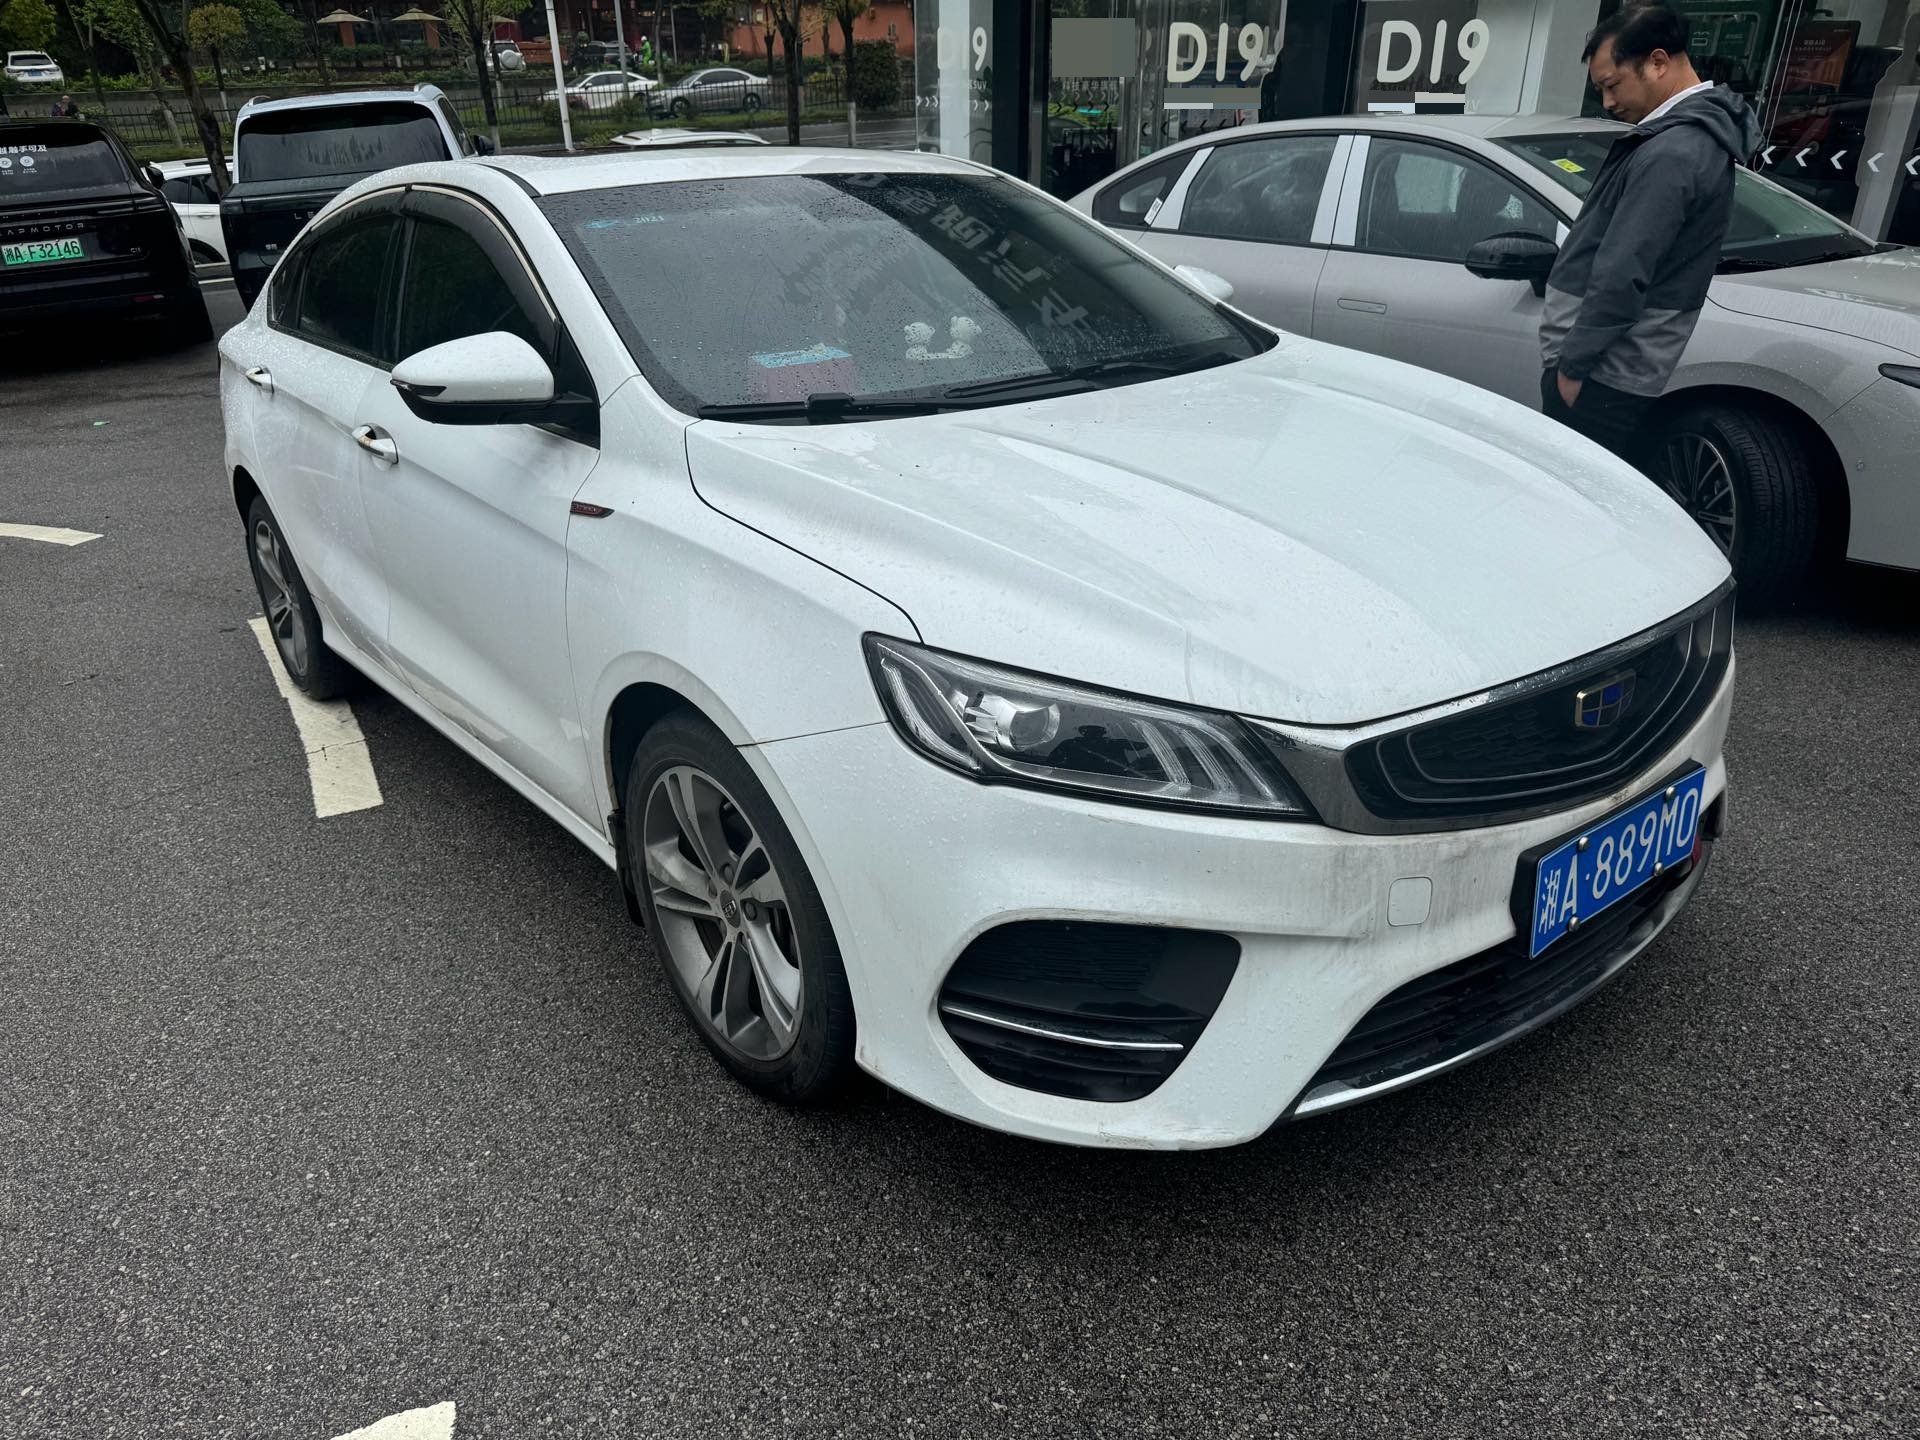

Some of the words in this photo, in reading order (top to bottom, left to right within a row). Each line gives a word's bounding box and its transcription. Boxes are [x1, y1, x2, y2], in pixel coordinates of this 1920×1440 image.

[1167, 22, 1264, 82] D19
[1377, 19, 1490, 84] D19
[0, 222, 84, 237] APMOTOR
